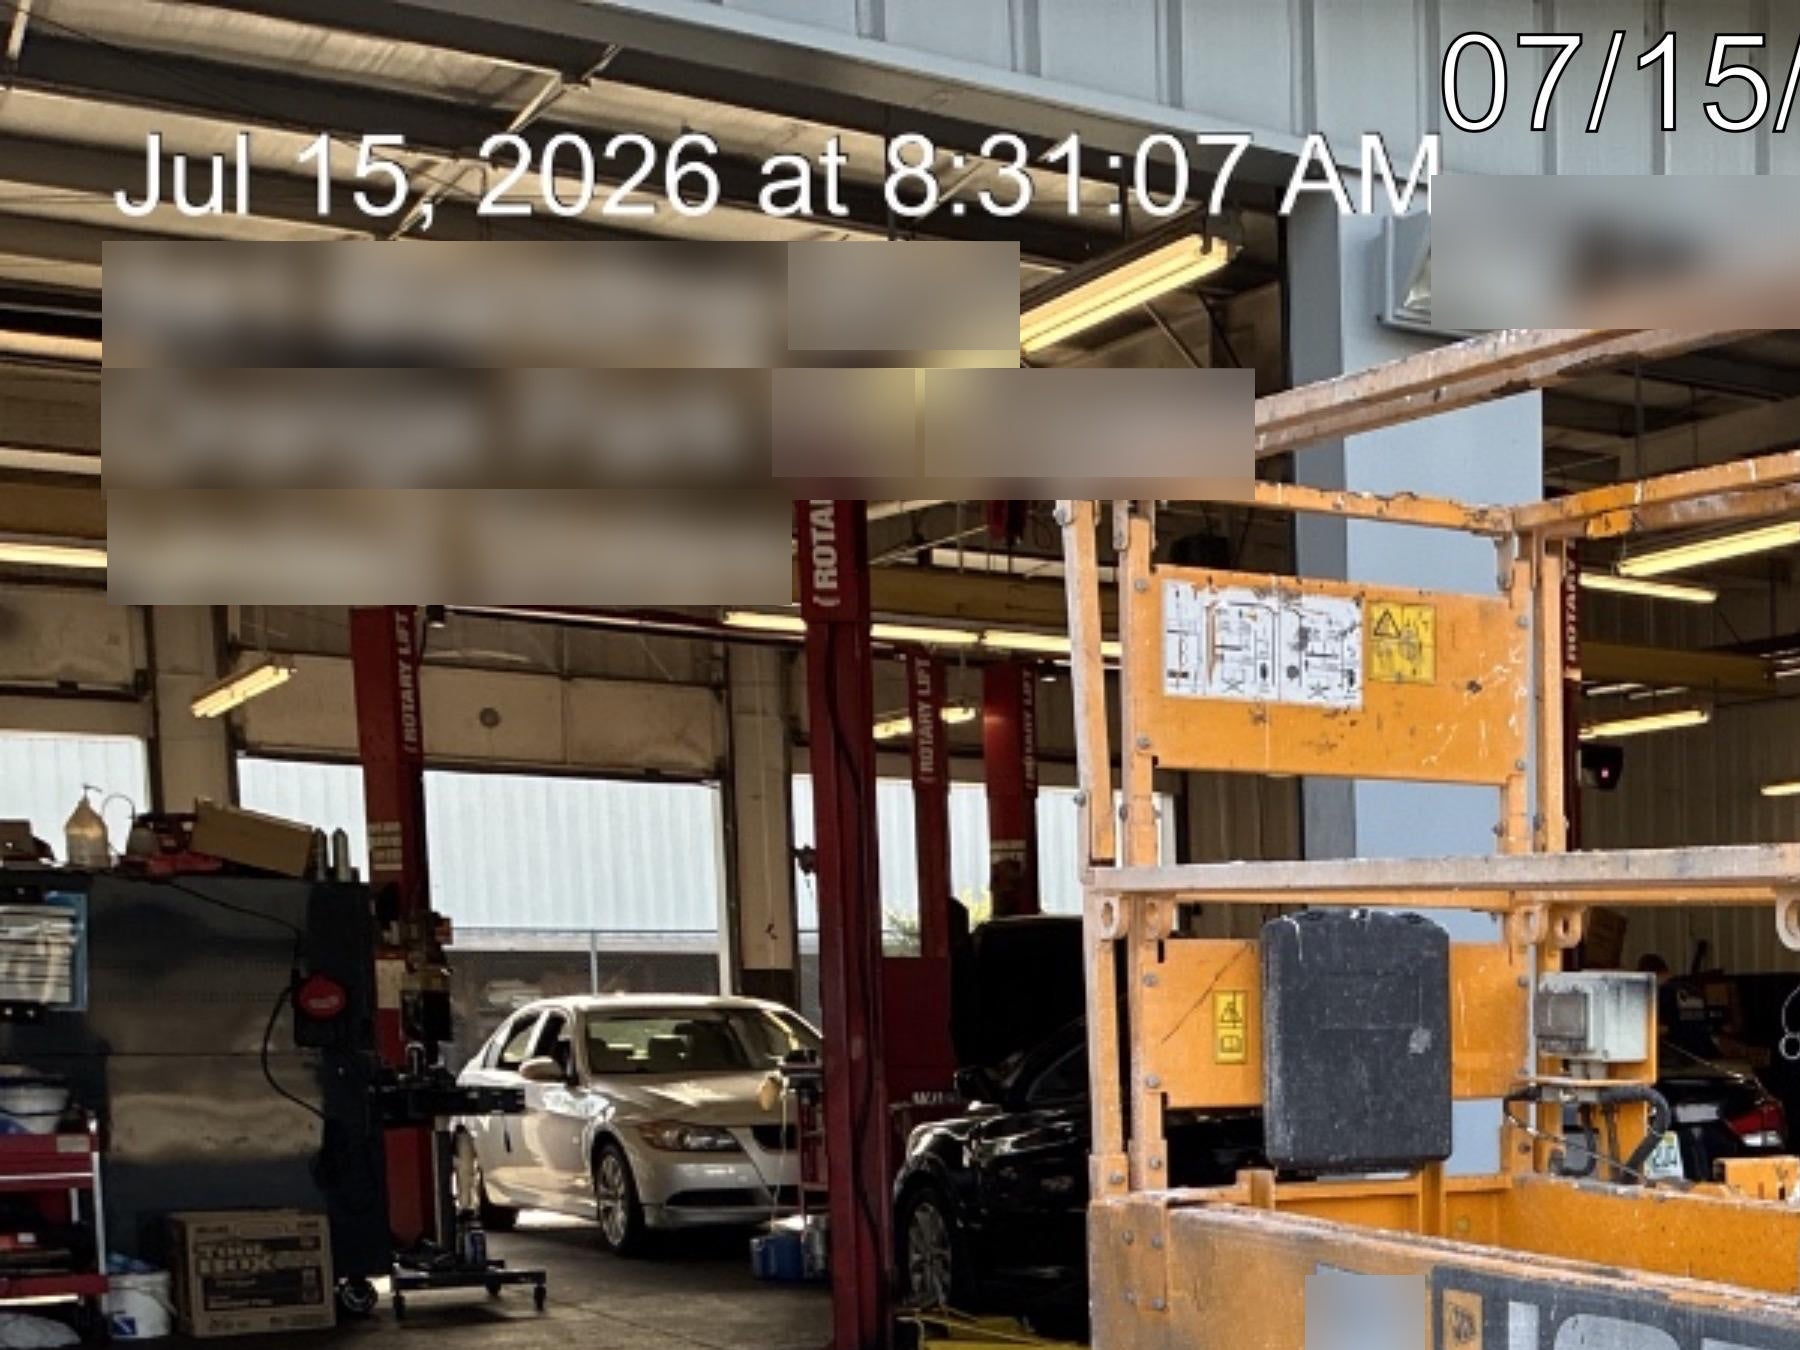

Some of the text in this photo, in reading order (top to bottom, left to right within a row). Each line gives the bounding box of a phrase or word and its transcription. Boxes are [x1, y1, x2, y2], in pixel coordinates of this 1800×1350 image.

[809, 500, 839, 590] ROTA
[395, 611, 418, 743] ROTARY LIFT
[914, 657, 935, 773] ROTARY LIFT
